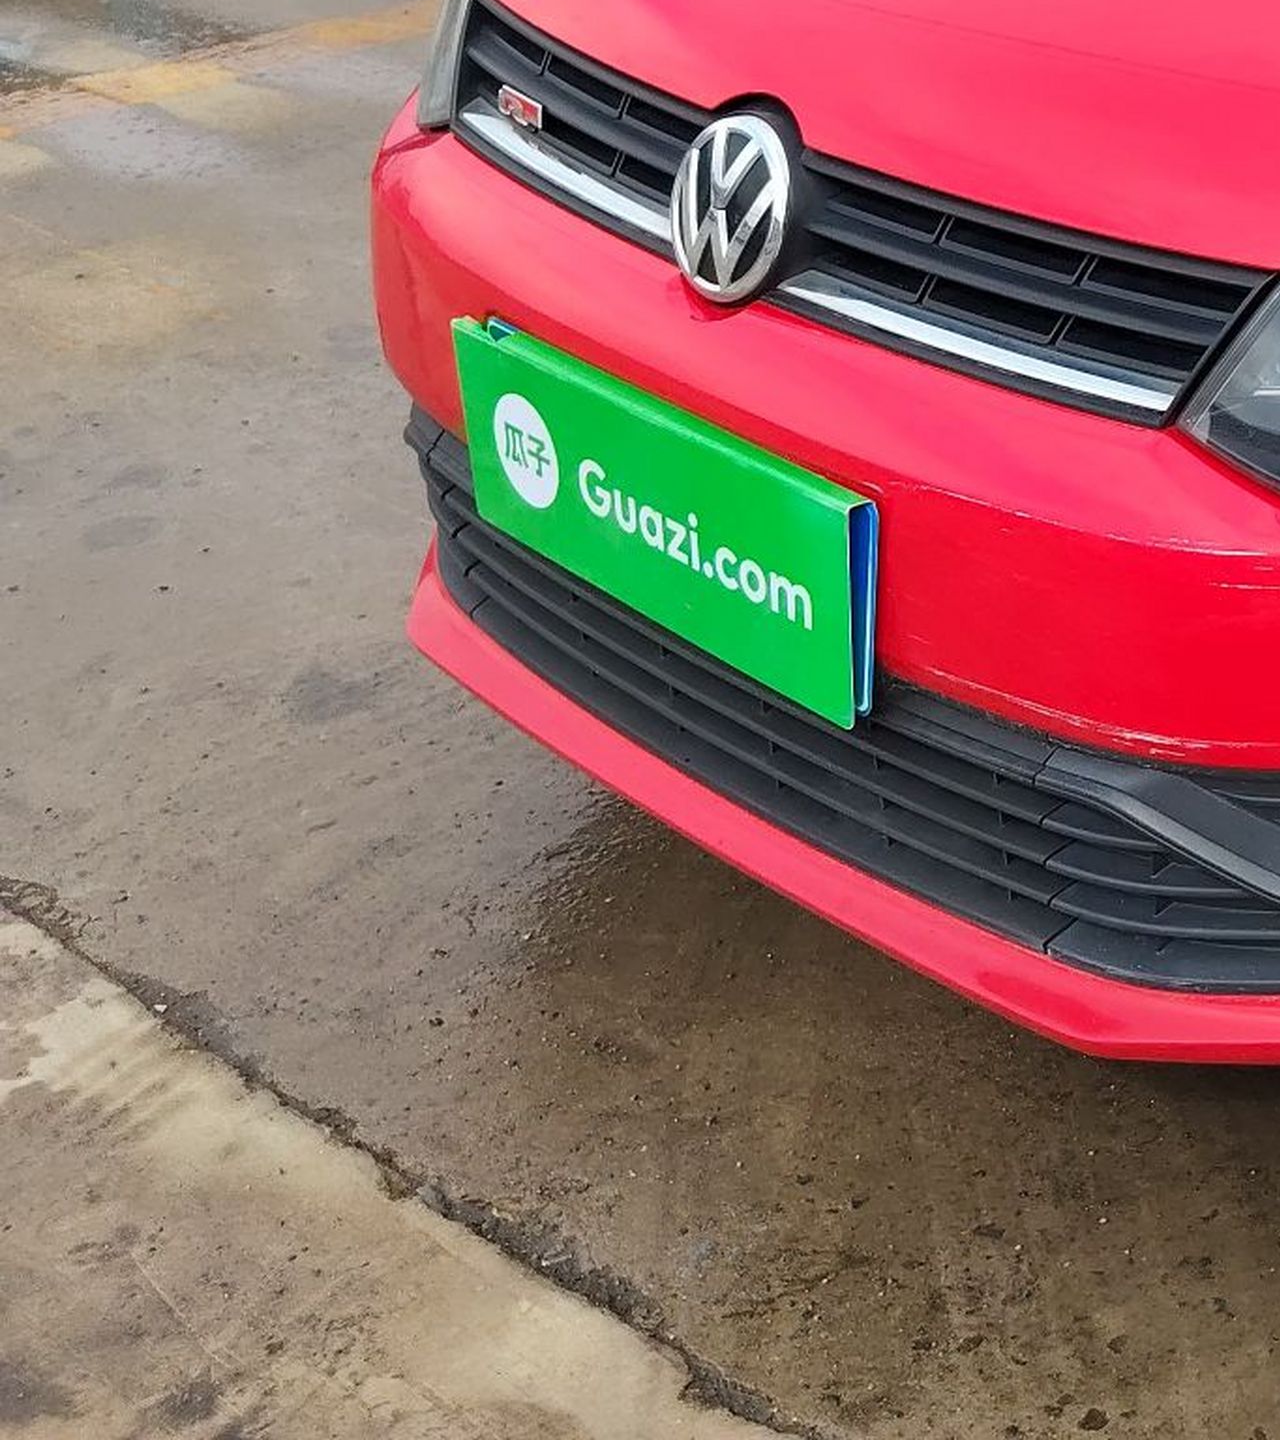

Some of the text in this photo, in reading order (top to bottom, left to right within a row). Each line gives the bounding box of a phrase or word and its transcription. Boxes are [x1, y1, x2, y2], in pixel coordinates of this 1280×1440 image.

[671, 114, 788, 302] VW
[504, 421, 551, 477] 瓜子
[578, 458, 813, 631] Guazi.com
